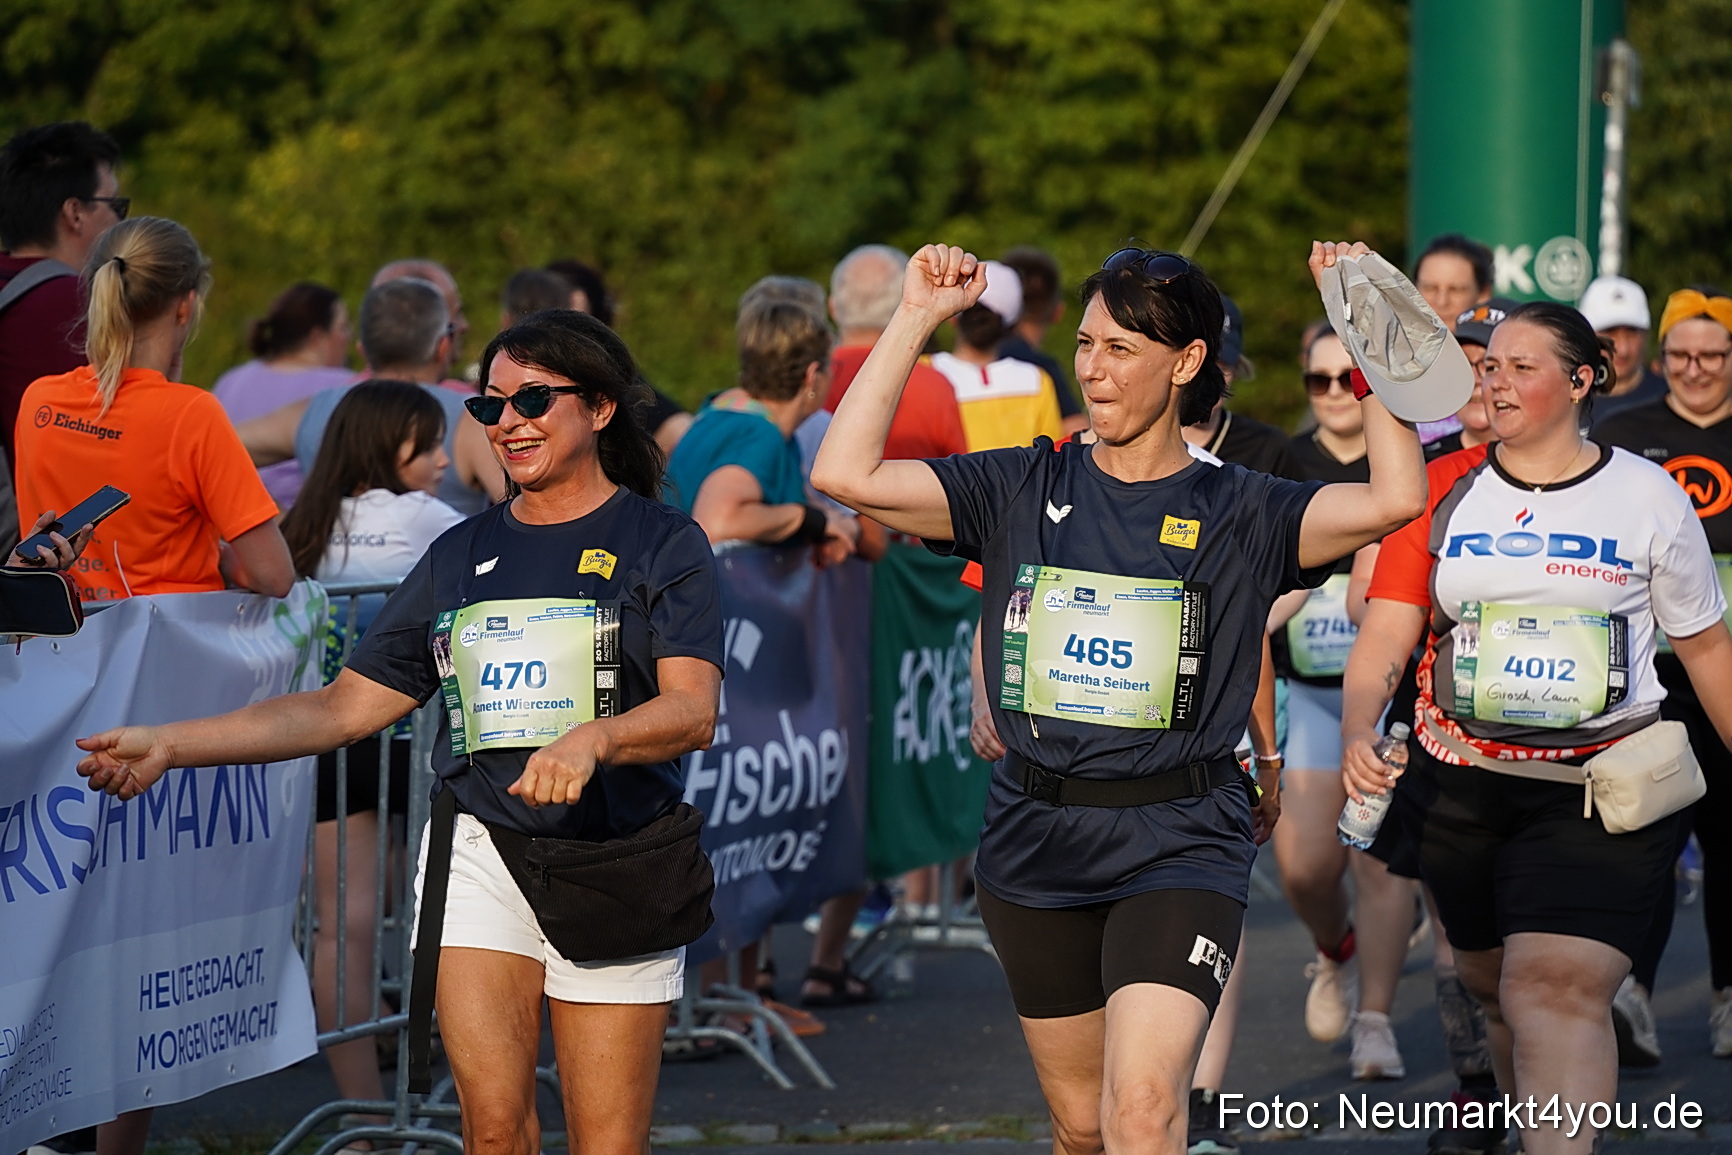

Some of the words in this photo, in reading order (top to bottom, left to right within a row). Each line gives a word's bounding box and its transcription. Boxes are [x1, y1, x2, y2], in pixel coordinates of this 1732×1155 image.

[54, 412, 122, 440] Eichinger
[1163, 524, 1195, 541] Burgis
[583, 555, 611, 569] Burgis
[1018, 576, 1034, 584] AOK
[1066, 601, 1111, 612] Firmenlauf
[1182, 590, 1191, 626] RABATT
[437, 621, 452, 629] AOK
[480, 628, 524, 640] Firmenlauf
[1182, 626, 1188, 634] %
[1063, 633, 1133, 669] 465
[1181, 636, 1188, 648] 20
[596, 649, 602, 662] 20
[481, 660, 547, 690] 470
[1503, 655, 1576, 682] 4012
[1048, 669, 1100, 687] Maretha
[1103, 676, 1151, 692] Seibert
[505, 698, 574, 710] Wierczoch
[599, 692, 609, 717] LTL
[1176, 678, 1190, 719] HILTL
[1541, 687, 1581, 704] Laura
[0, 764, 271, 903] RISHMANN
[139, 964, 195, 1012] HEUTE
[195, 947, 265, 998] GEDACHT,
[137, 1020, 209, 1073] MORGEN
[209, 1001, 278, 1054] GEMACHT.
